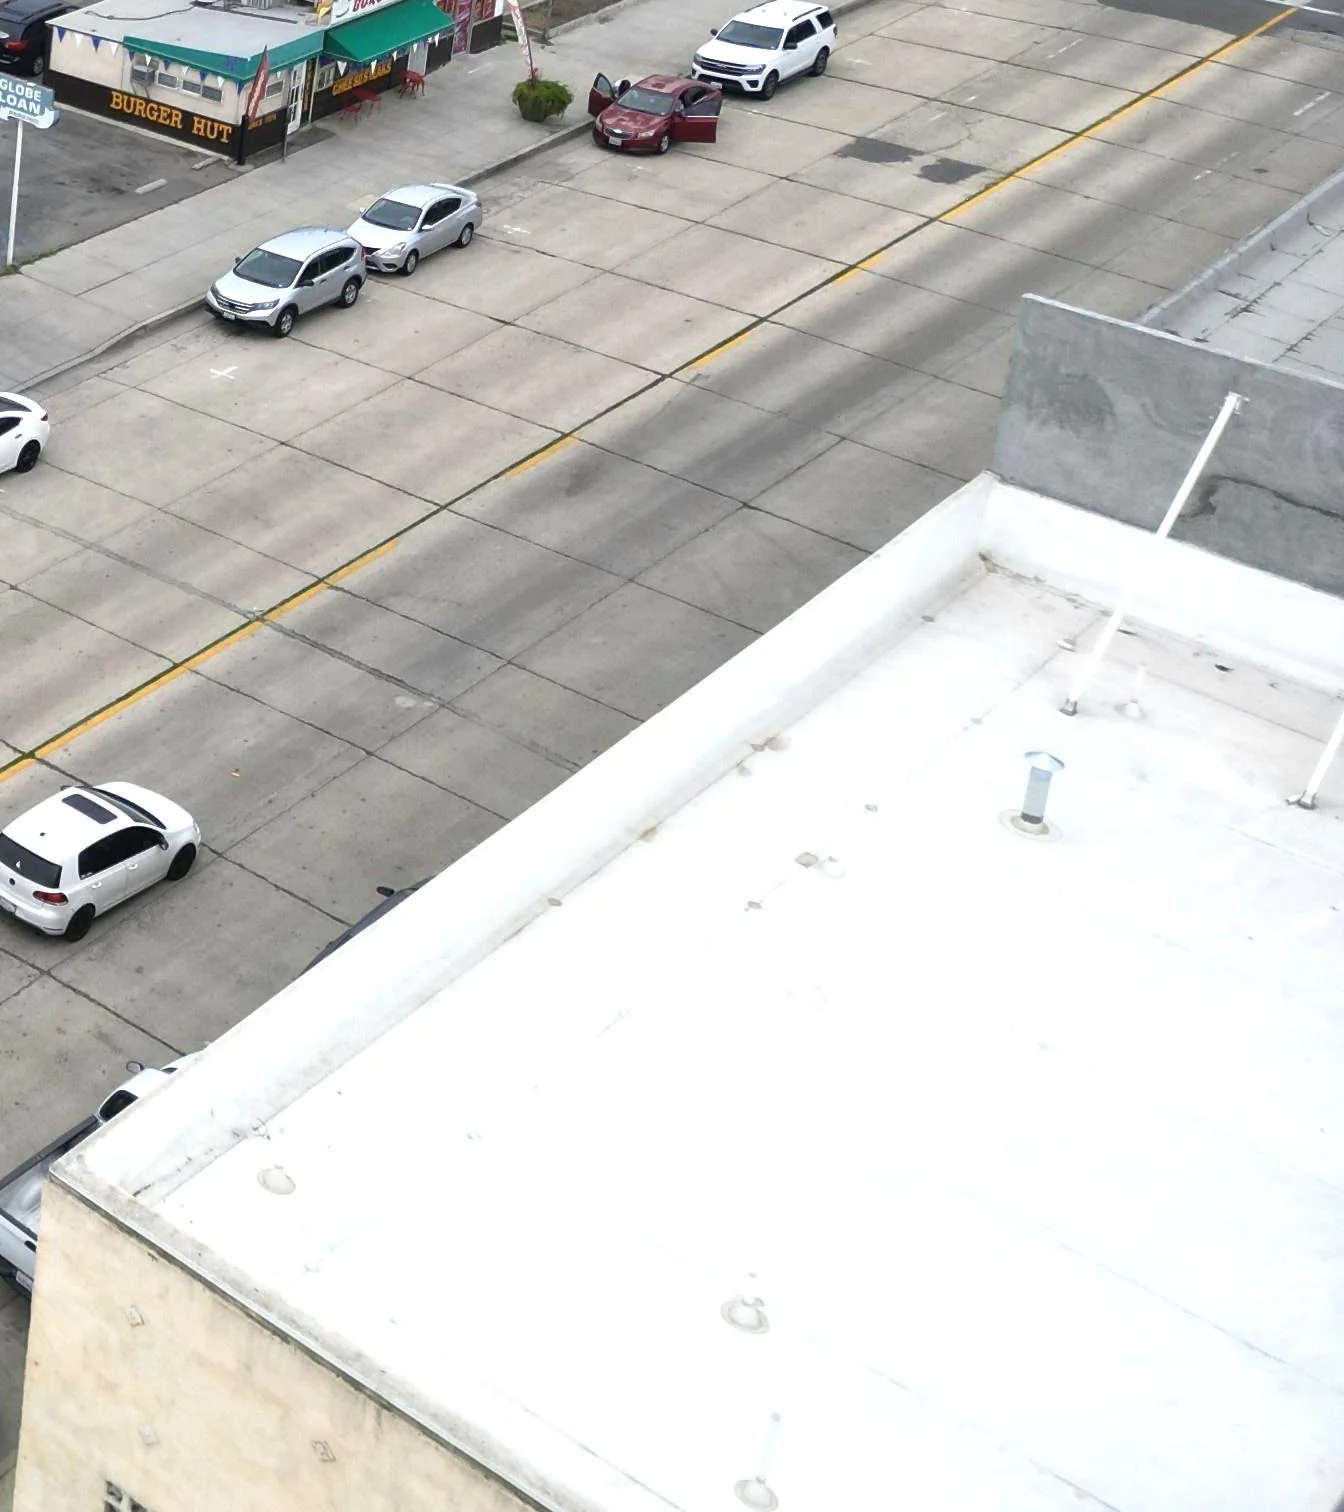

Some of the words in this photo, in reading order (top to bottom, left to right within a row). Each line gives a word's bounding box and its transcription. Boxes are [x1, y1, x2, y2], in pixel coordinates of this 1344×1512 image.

[0, 78, 42, 102] GLOBE
[109, 91, 183, 129] BURGER
[191, 116, 232, 144] HUT
